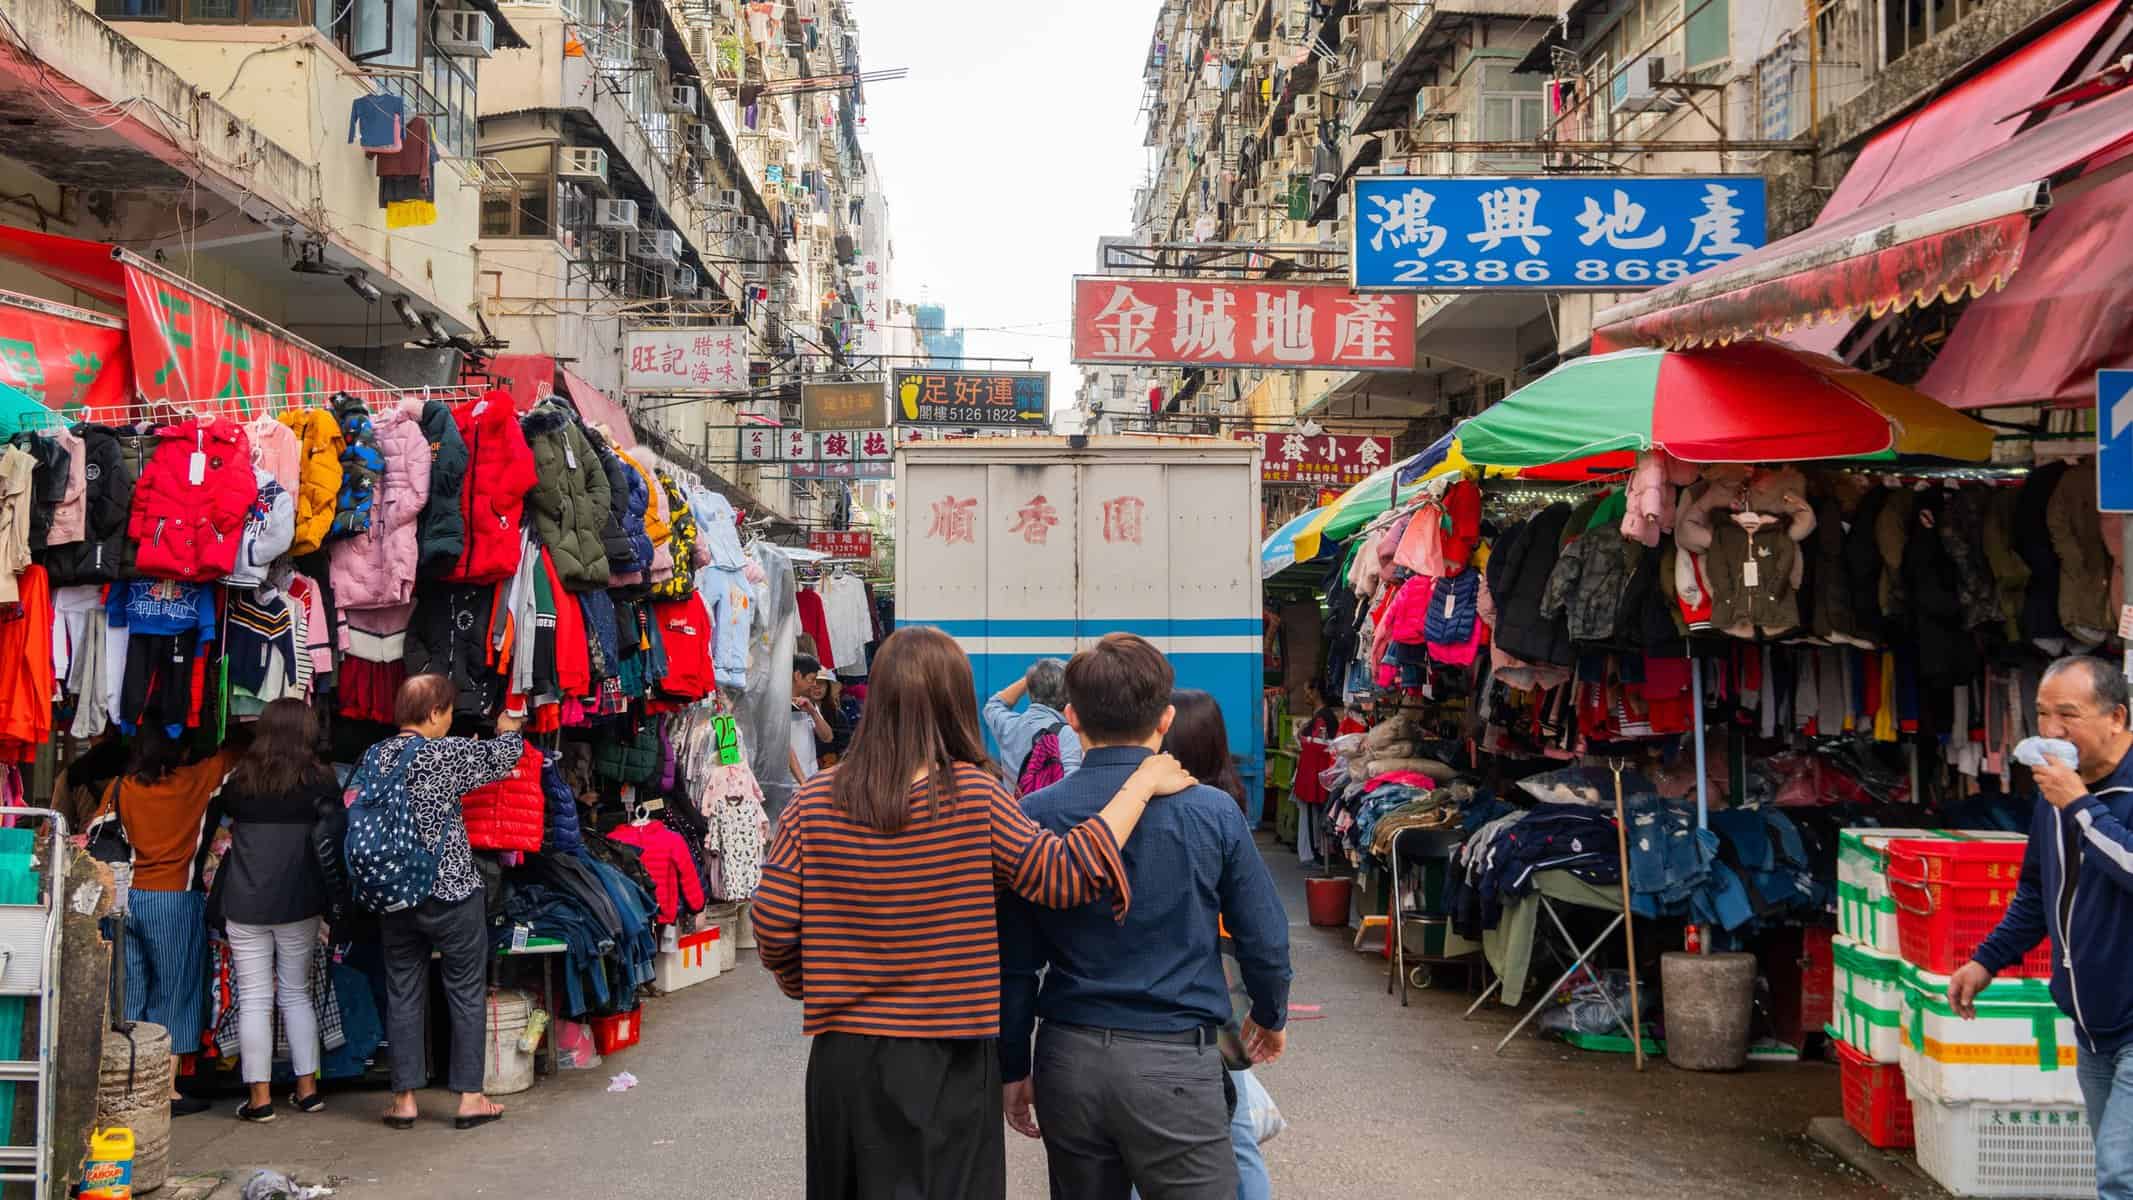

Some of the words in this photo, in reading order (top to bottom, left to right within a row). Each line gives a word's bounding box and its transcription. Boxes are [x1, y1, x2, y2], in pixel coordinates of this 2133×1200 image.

[1368, 183, 1754, 258] 鴻興地產
[1393, 259, 1550, 282] 2386
[1093, 285, 1396, 361] 金城地產
[631, 344, 689, 375] 旺記
[691, 361, 738, 384] 海味
[922, 375, 1014, 406] 足好運
[949, 408, 982, 420] 5126
[986, 409, 1017, 422] 1822
